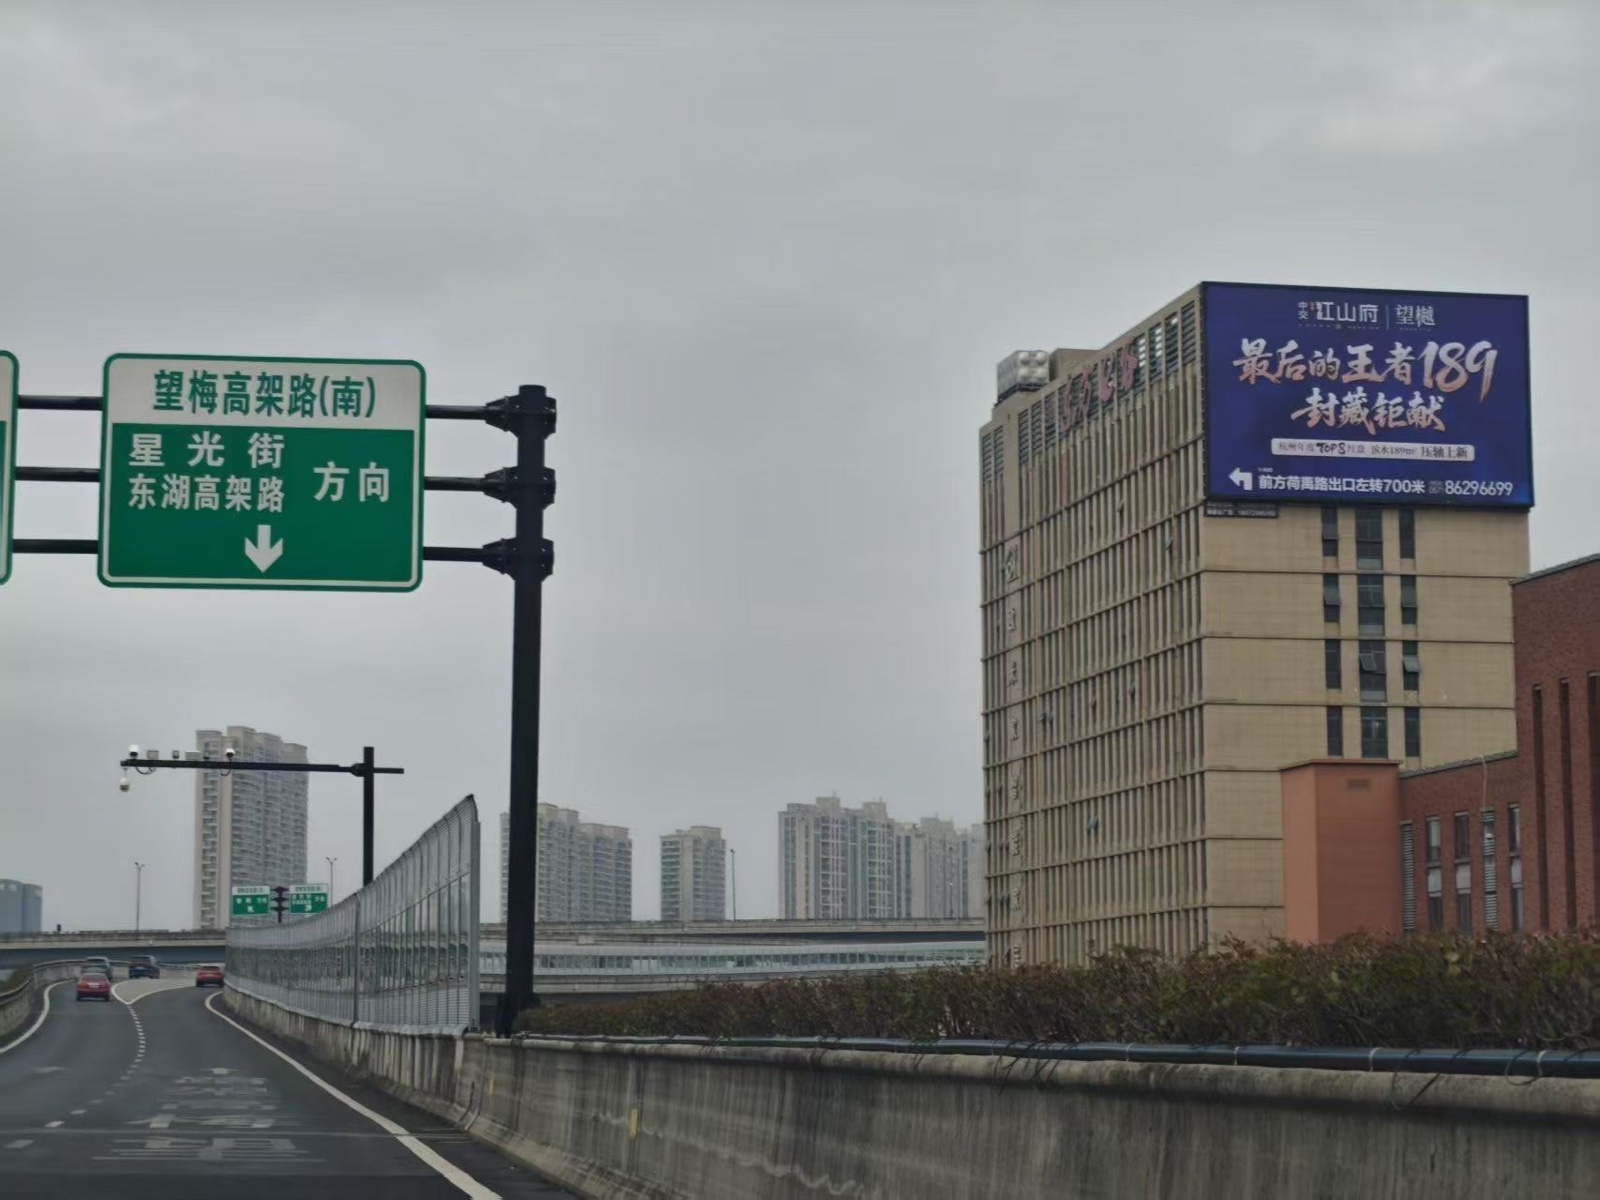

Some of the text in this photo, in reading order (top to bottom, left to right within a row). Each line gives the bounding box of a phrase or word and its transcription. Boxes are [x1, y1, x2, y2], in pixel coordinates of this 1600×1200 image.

[1315, 301, 1379, 323] 江山府
[1232, 338, 1498, 403] 最后的王者189
[153, 369, 376, 418] 望梅高架路(南)
[1290, 386, 1446, 435] 封藏钜献
[129, 431, 285, 469] 星光街
[129, 474, 285, 513] 东湖高架路
[313, 461, 390, 502] 方向
[1445, 480, 1514, 496] 86296699
